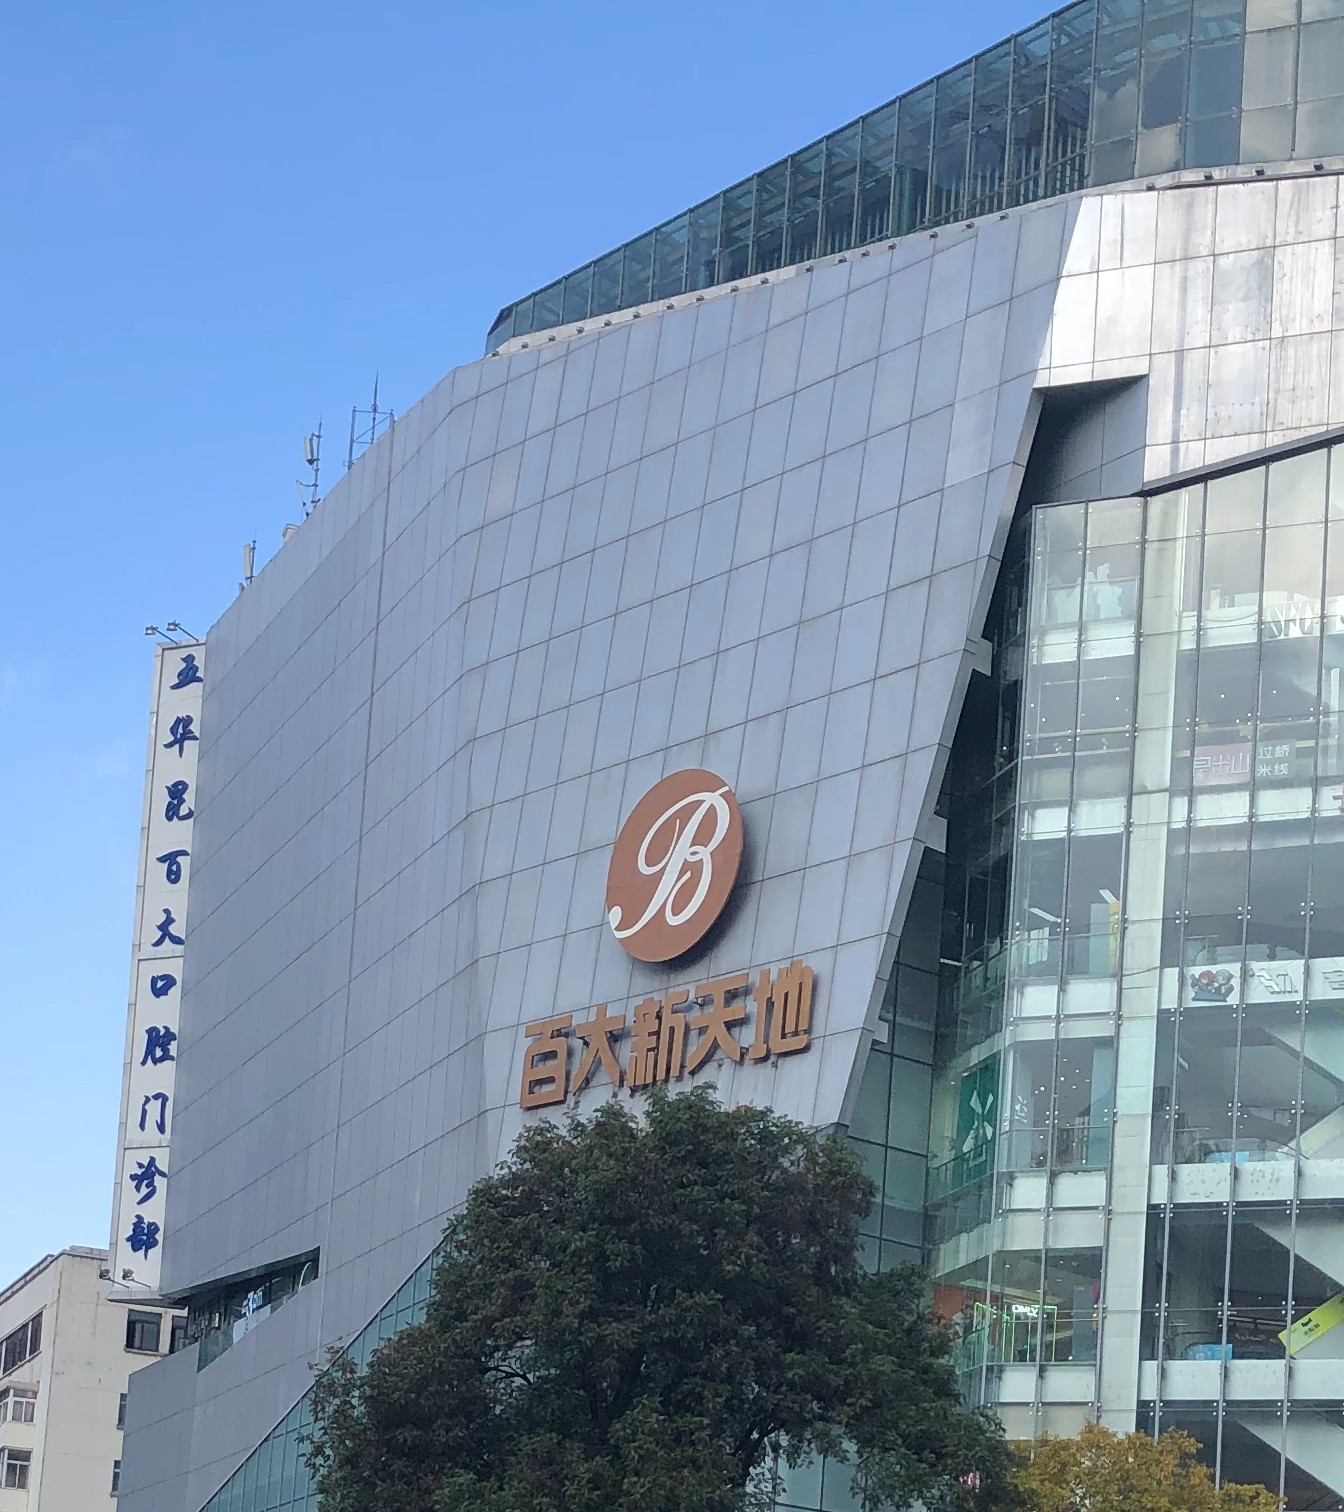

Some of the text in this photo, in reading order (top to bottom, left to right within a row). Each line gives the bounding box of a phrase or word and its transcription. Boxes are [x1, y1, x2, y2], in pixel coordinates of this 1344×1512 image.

[1258, 744, 1290, 759] 过桥
[1258, 763, 1289, 776] 米线
[125, 654, 204, 1260] 五华昆百大口腔门诊部
[520, 959, 815, 1109] 百大新天地
